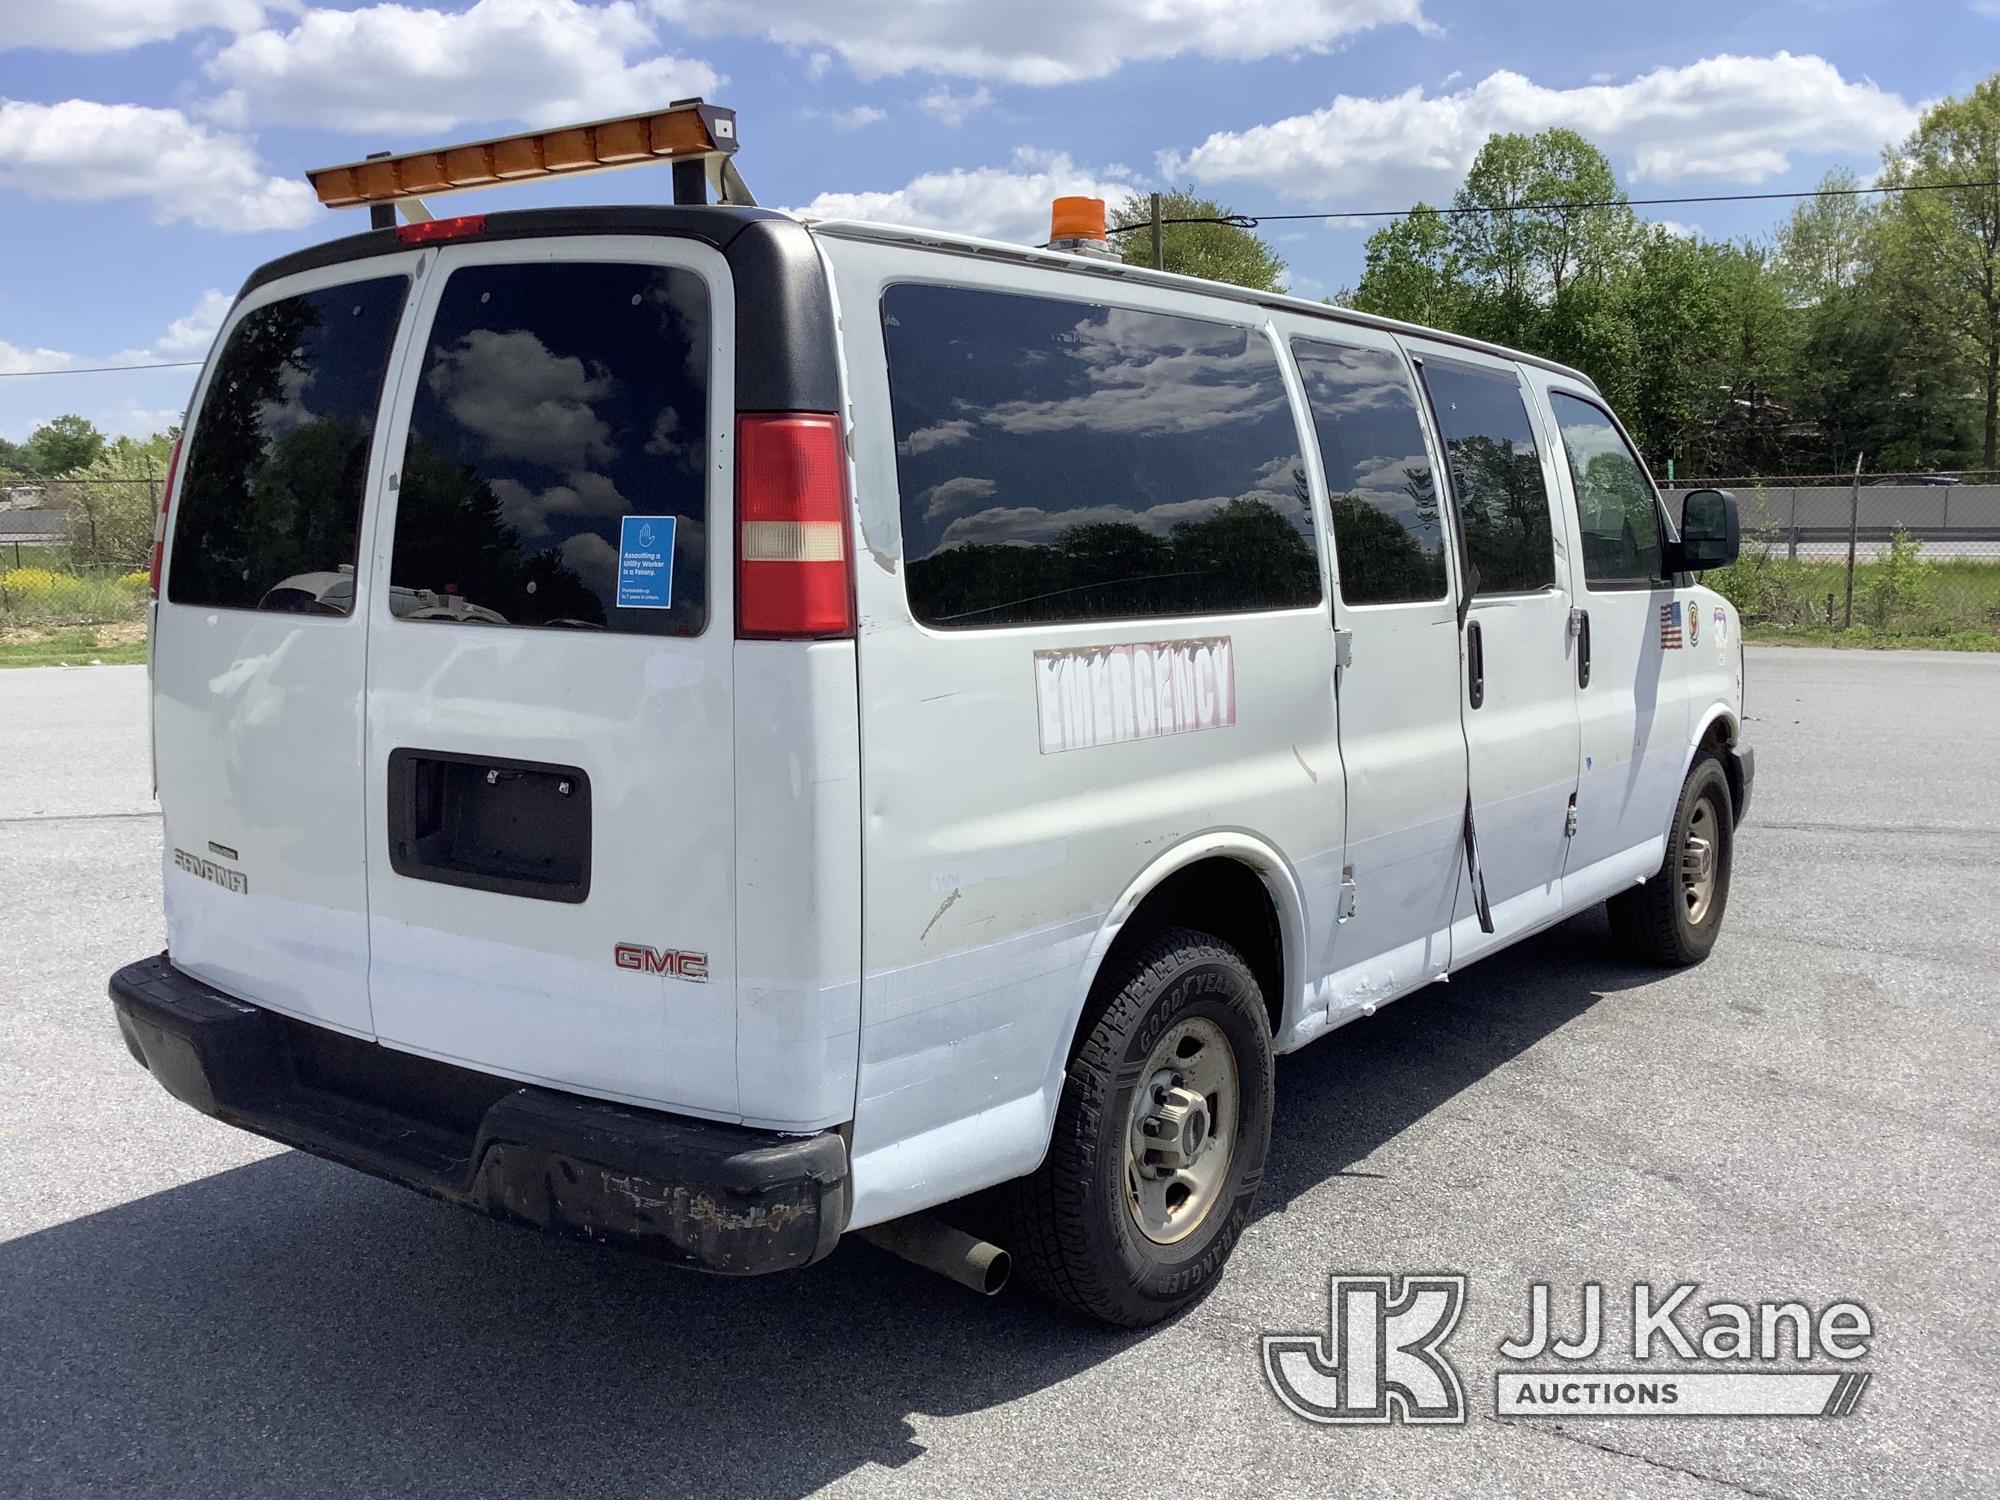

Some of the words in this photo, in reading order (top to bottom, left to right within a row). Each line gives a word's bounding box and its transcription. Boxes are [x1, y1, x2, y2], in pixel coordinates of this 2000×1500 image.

[623, 560, 641, 568] Utility
[624, 552, 655, 560] Assaulting
[634, 569, 656, 577] Felony.
[1036, 640, 1231, 752] EMERGENCY
[614, 941, 708, 984] GMC
[1140, 972, 1236, 1054] GOODYEAR
